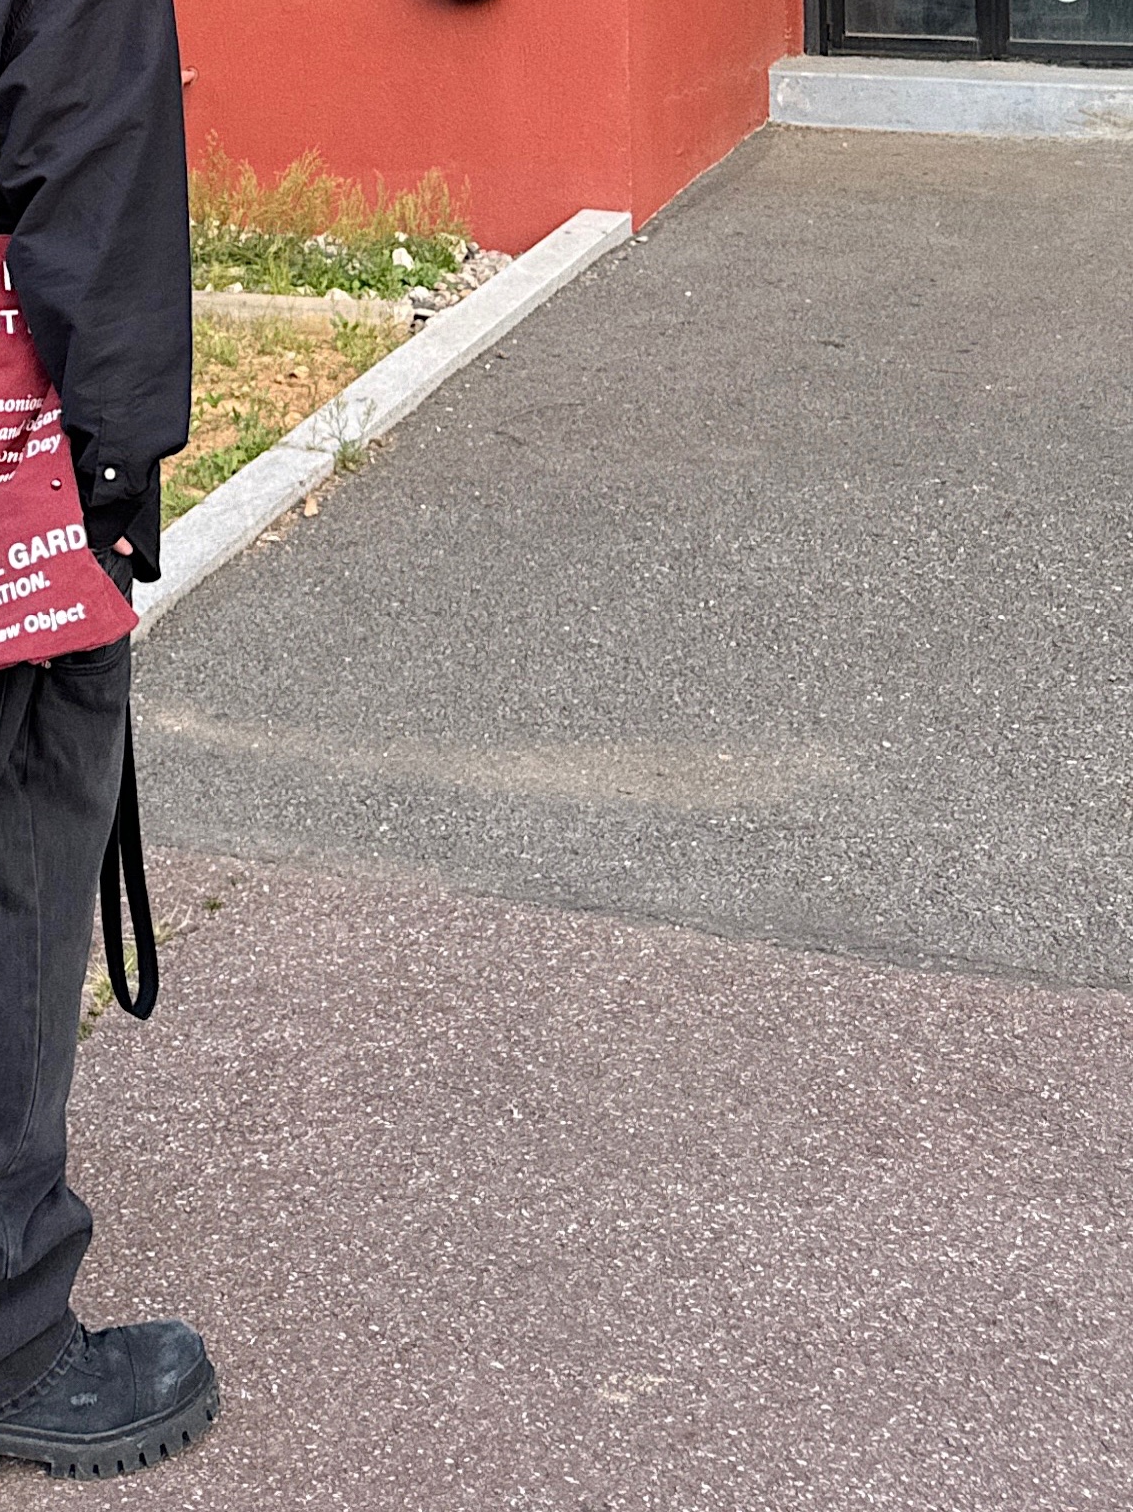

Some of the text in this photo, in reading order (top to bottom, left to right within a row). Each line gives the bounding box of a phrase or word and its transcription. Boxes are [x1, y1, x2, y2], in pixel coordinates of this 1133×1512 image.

[26, 434, 61, 459] Day
[8, 523, 88, 570] GARD
[23, 602, 87, 633] Object
